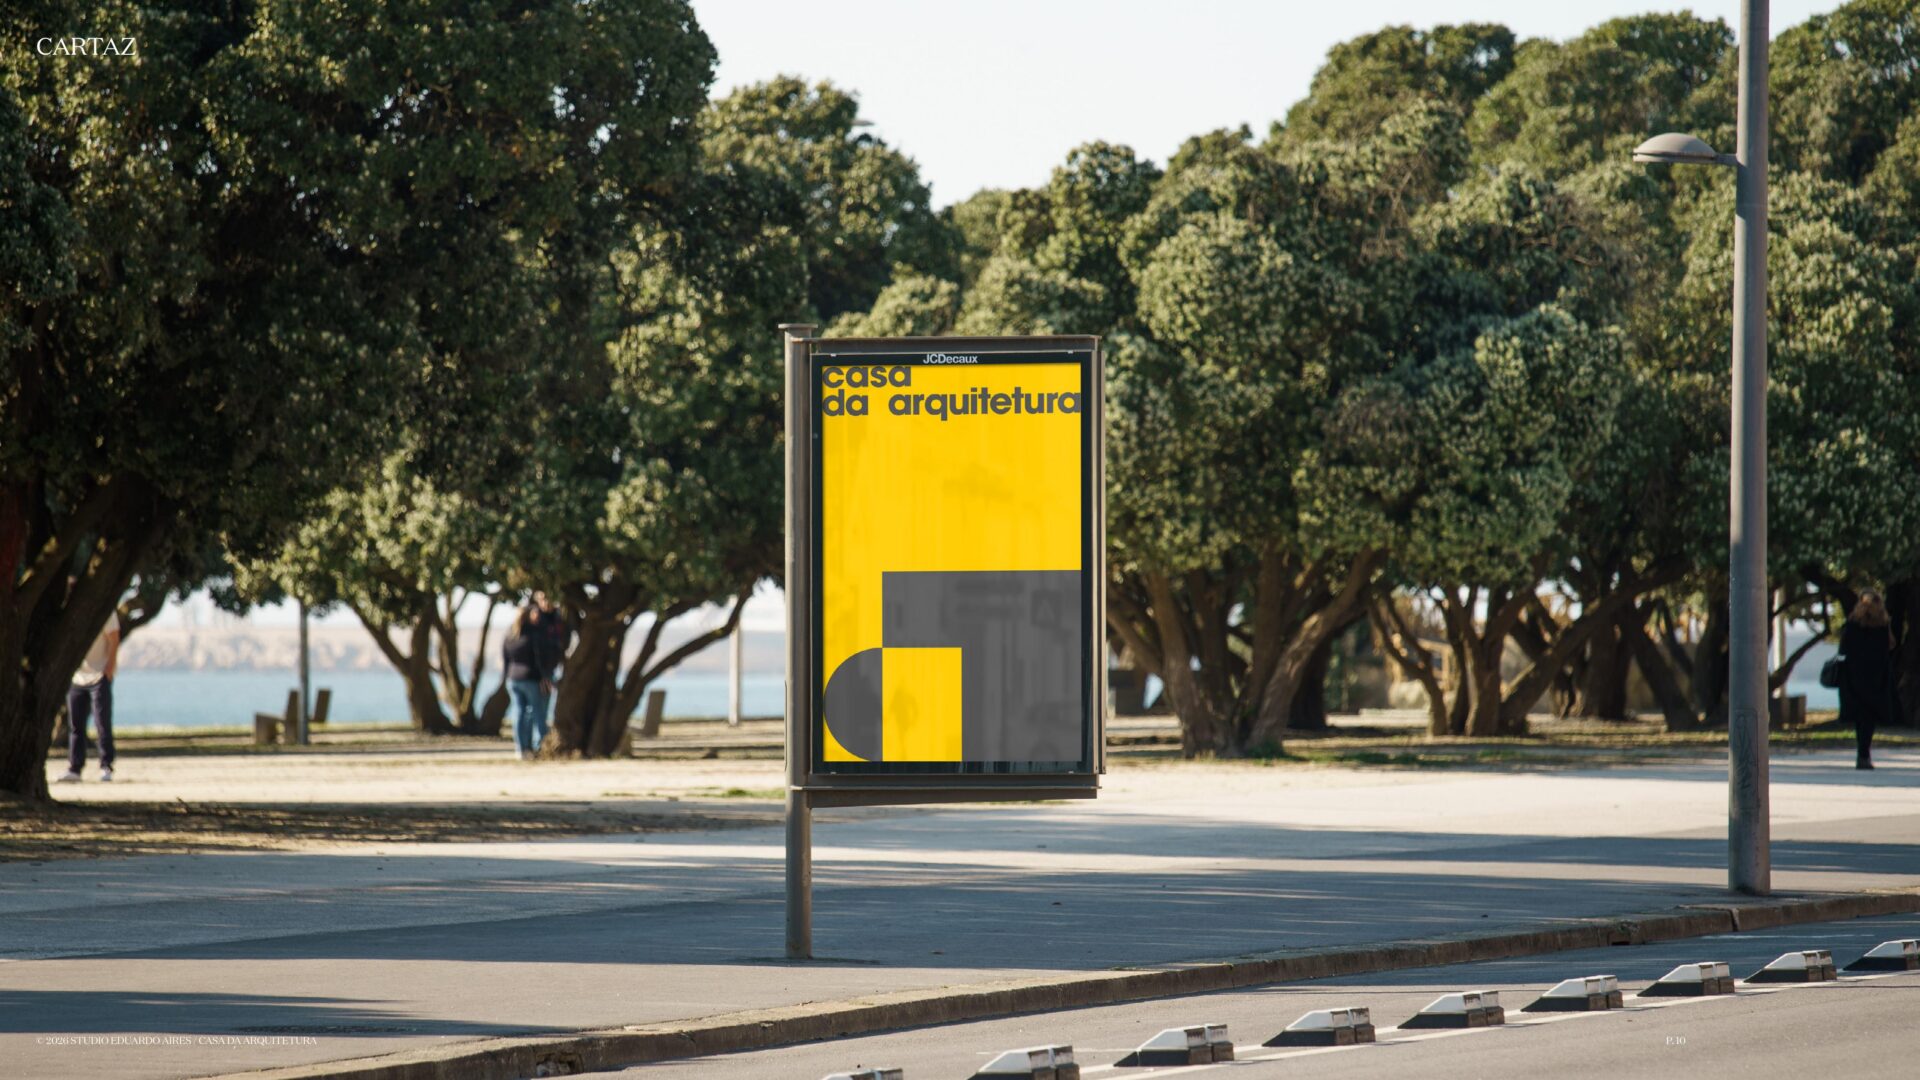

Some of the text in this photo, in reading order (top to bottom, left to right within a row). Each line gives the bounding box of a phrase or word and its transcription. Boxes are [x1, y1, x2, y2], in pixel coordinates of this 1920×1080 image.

[922, 353, 978, 364] JCDecaux
[822, 365, 912, 388] casa
[822, 387, 1081, 421] da arquitetura
